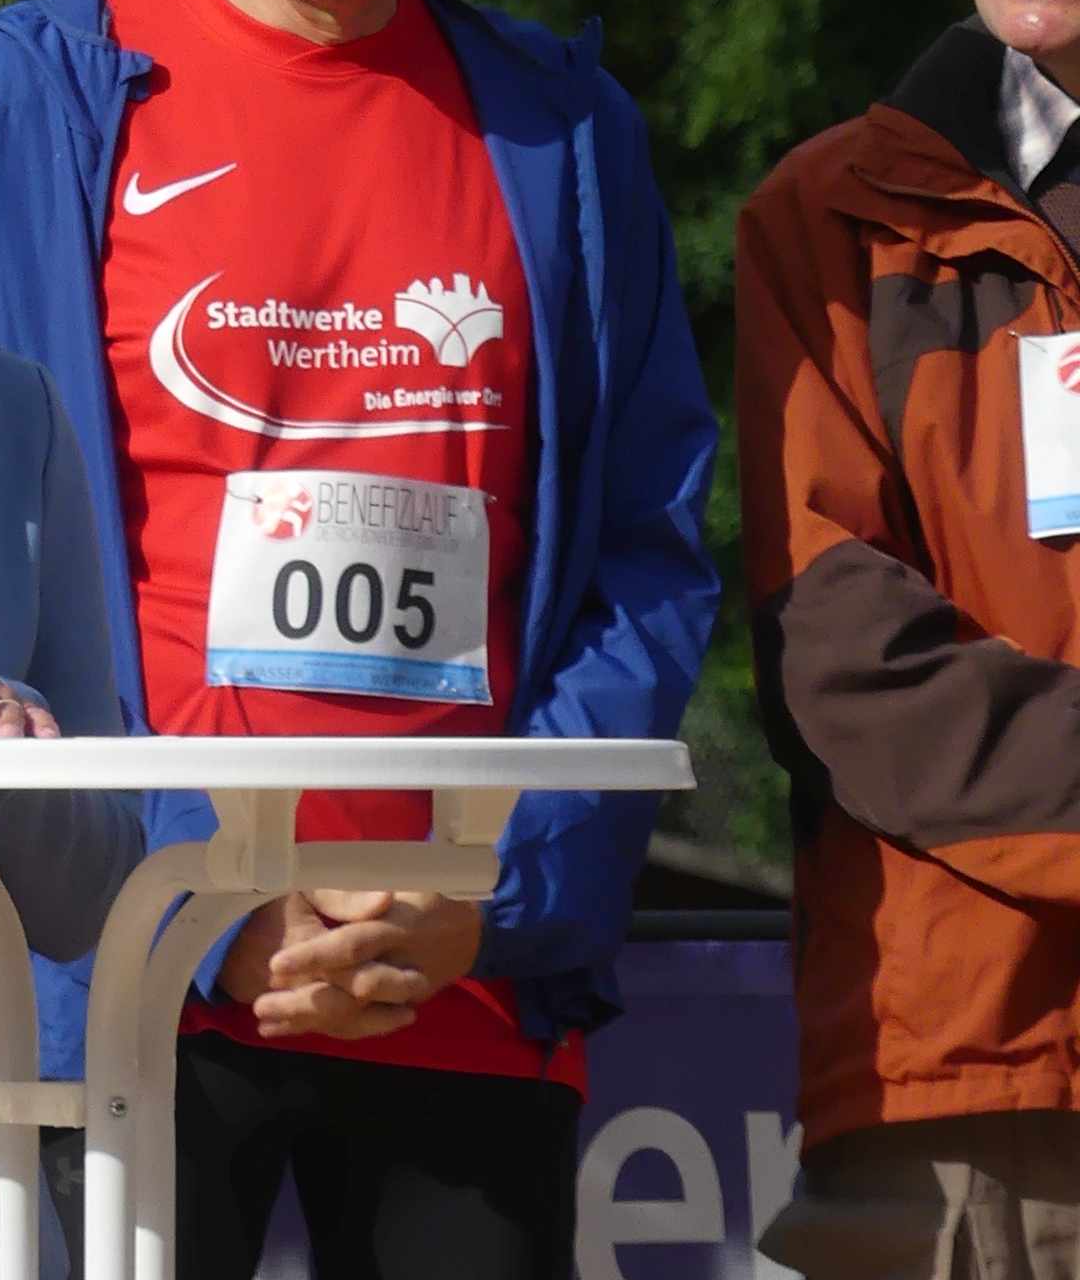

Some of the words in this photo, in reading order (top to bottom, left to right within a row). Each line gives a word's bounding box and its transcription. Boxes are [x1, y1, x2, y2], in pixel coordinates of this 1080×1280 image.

[206, 302, 383, 331] Stadtwerke
[268, 338, 420, 369] Wertheim
[363, 392, 392, 411] Die
[393, 385, 454, 408] Energie
[455, 390, 482, 405] vor
[316, 482, 460, 536] BENEFIZLAUF
[272, 559, 436, 649] 005
